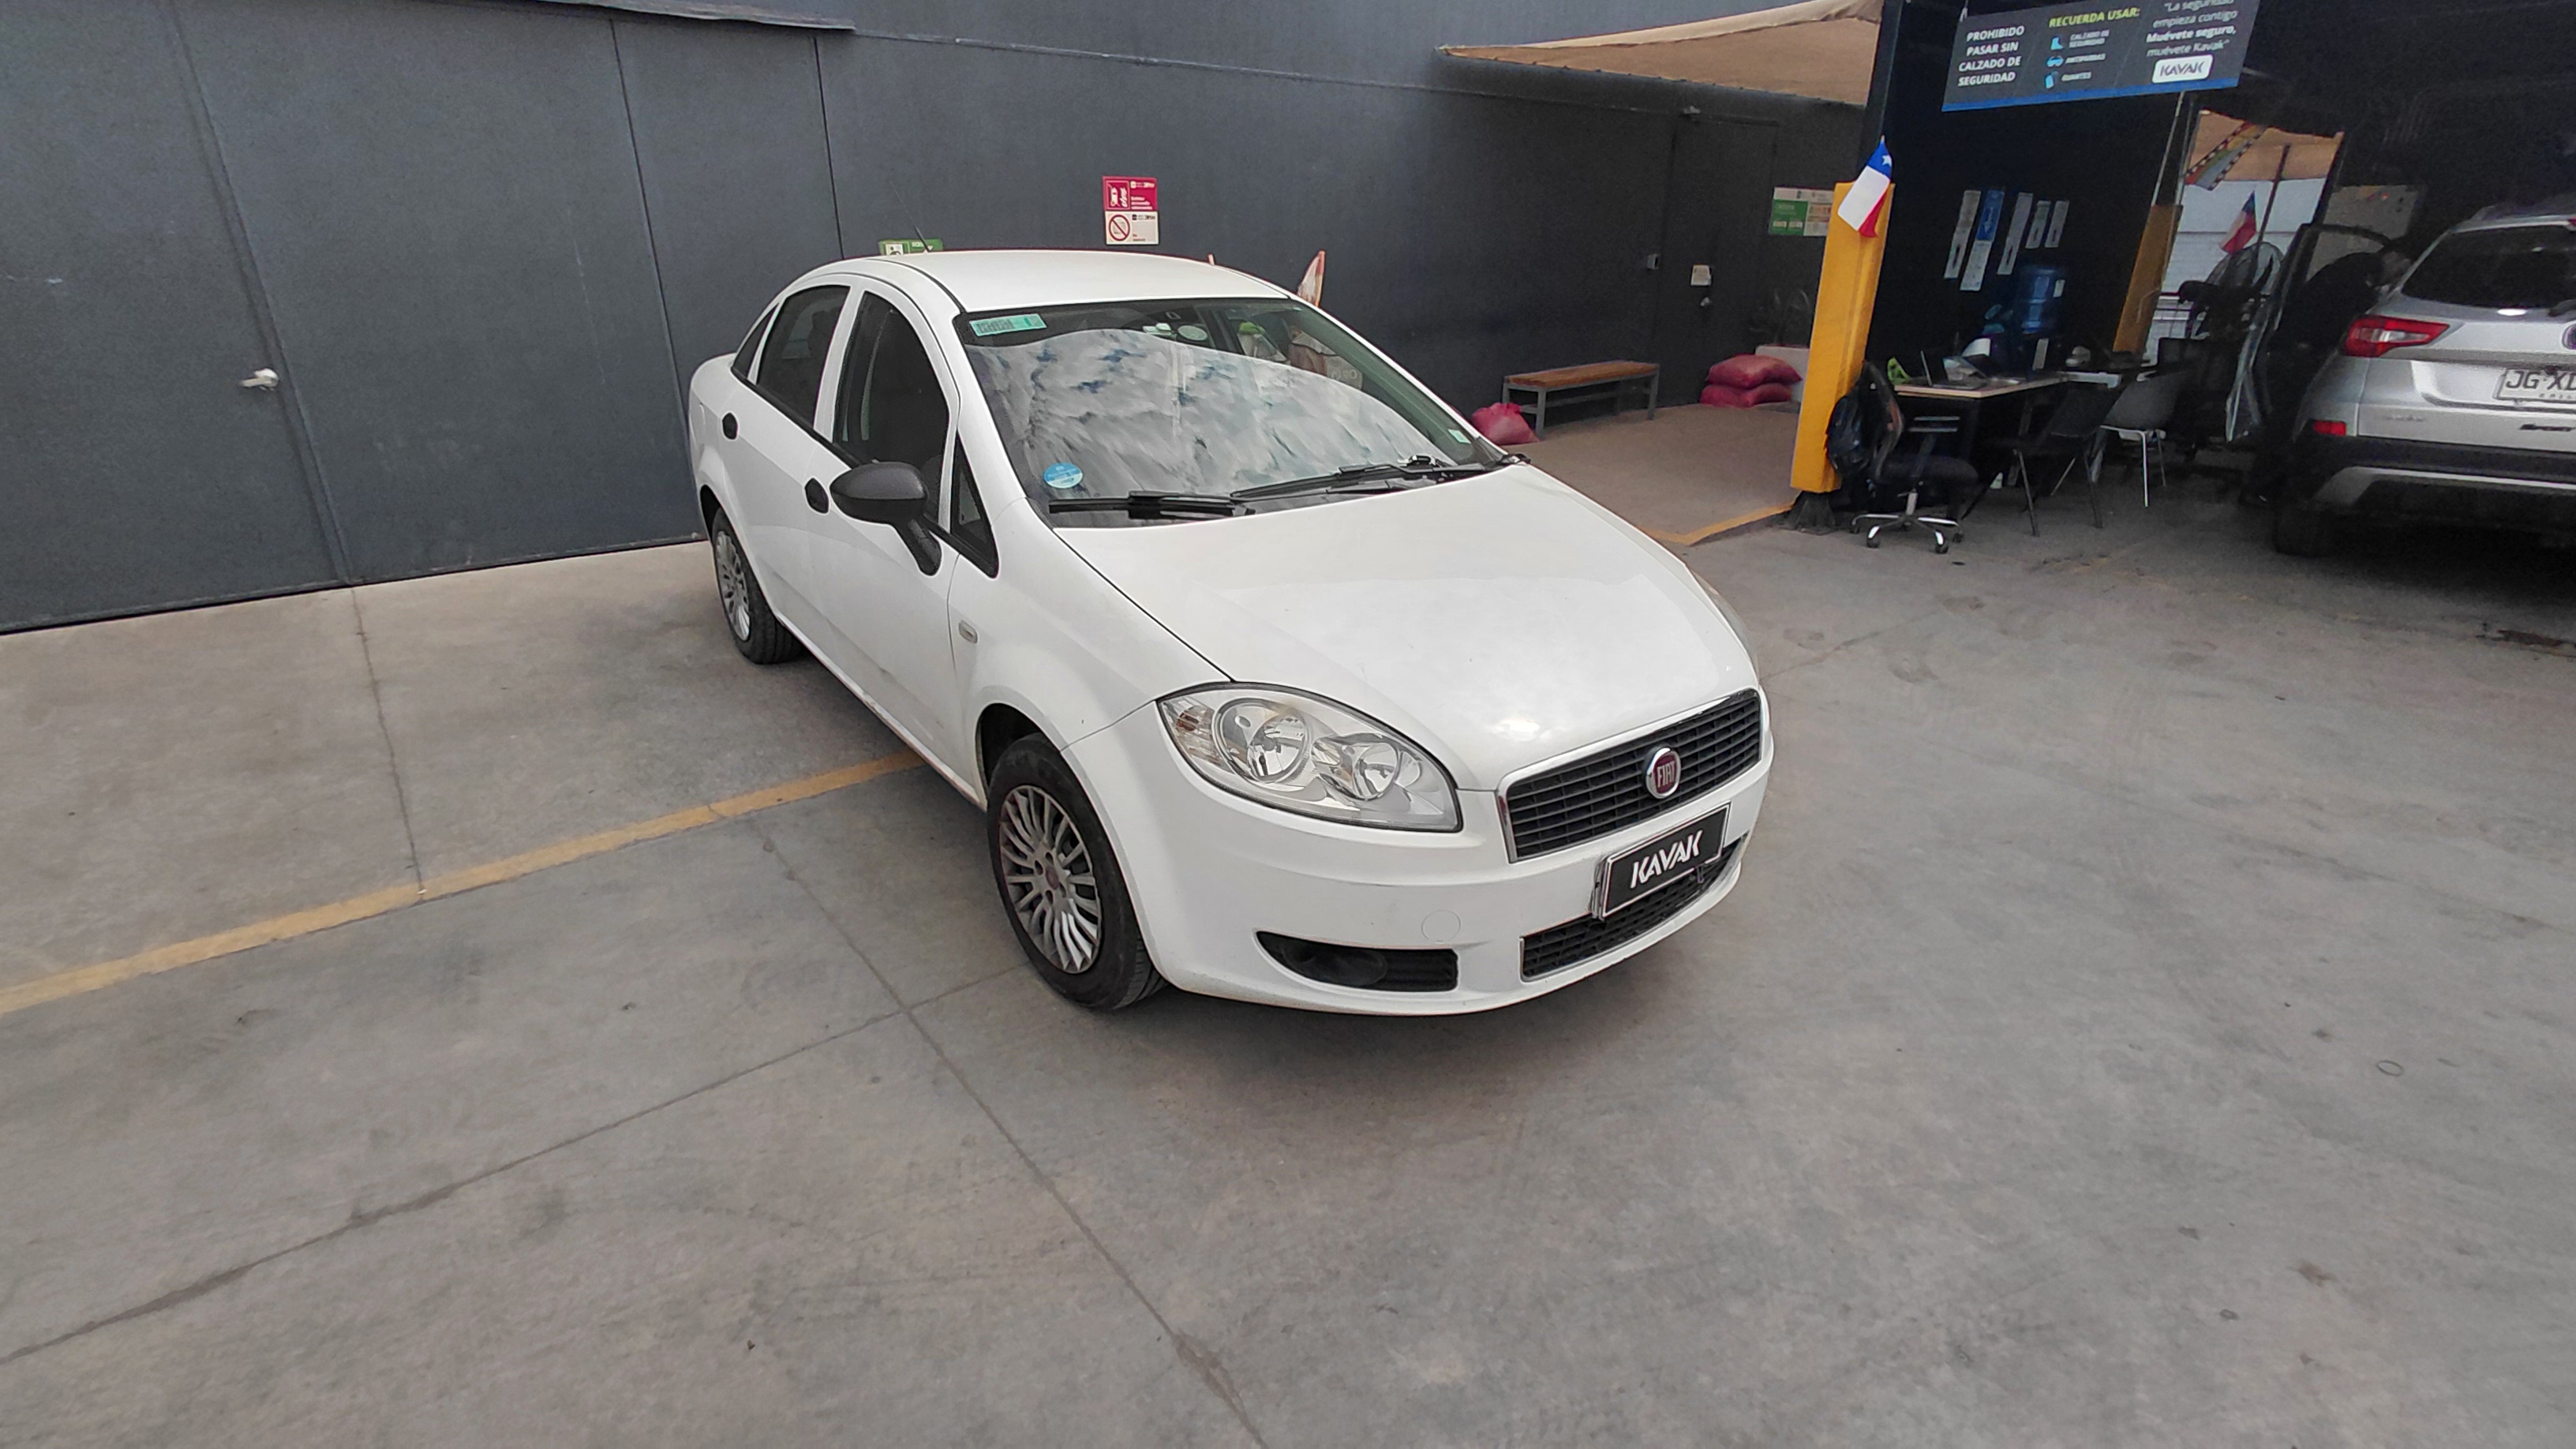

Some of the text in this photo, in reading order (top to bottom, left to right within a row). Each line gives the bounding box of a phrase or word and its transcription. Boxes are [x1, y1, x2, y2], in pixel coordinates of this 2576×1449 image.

[2049, 7, 2140, 28] RECUERDA USAR:
[2153, 10, 2238, 28] empieza contigo
[1967, 25, 2024, 42] PROHIBIDO
[1966, 42, 2019, 57] PASAR SIN
[1959, 56, 2021, 72] CALZADO DE
[2160, 61, 2205, 77] KAVAK
[1957, 72, 2016, 87] SEGURIDAD
[1657, 760, 1676, 788] FIAT
[1630, 829, 1703, 889] KAVAK
